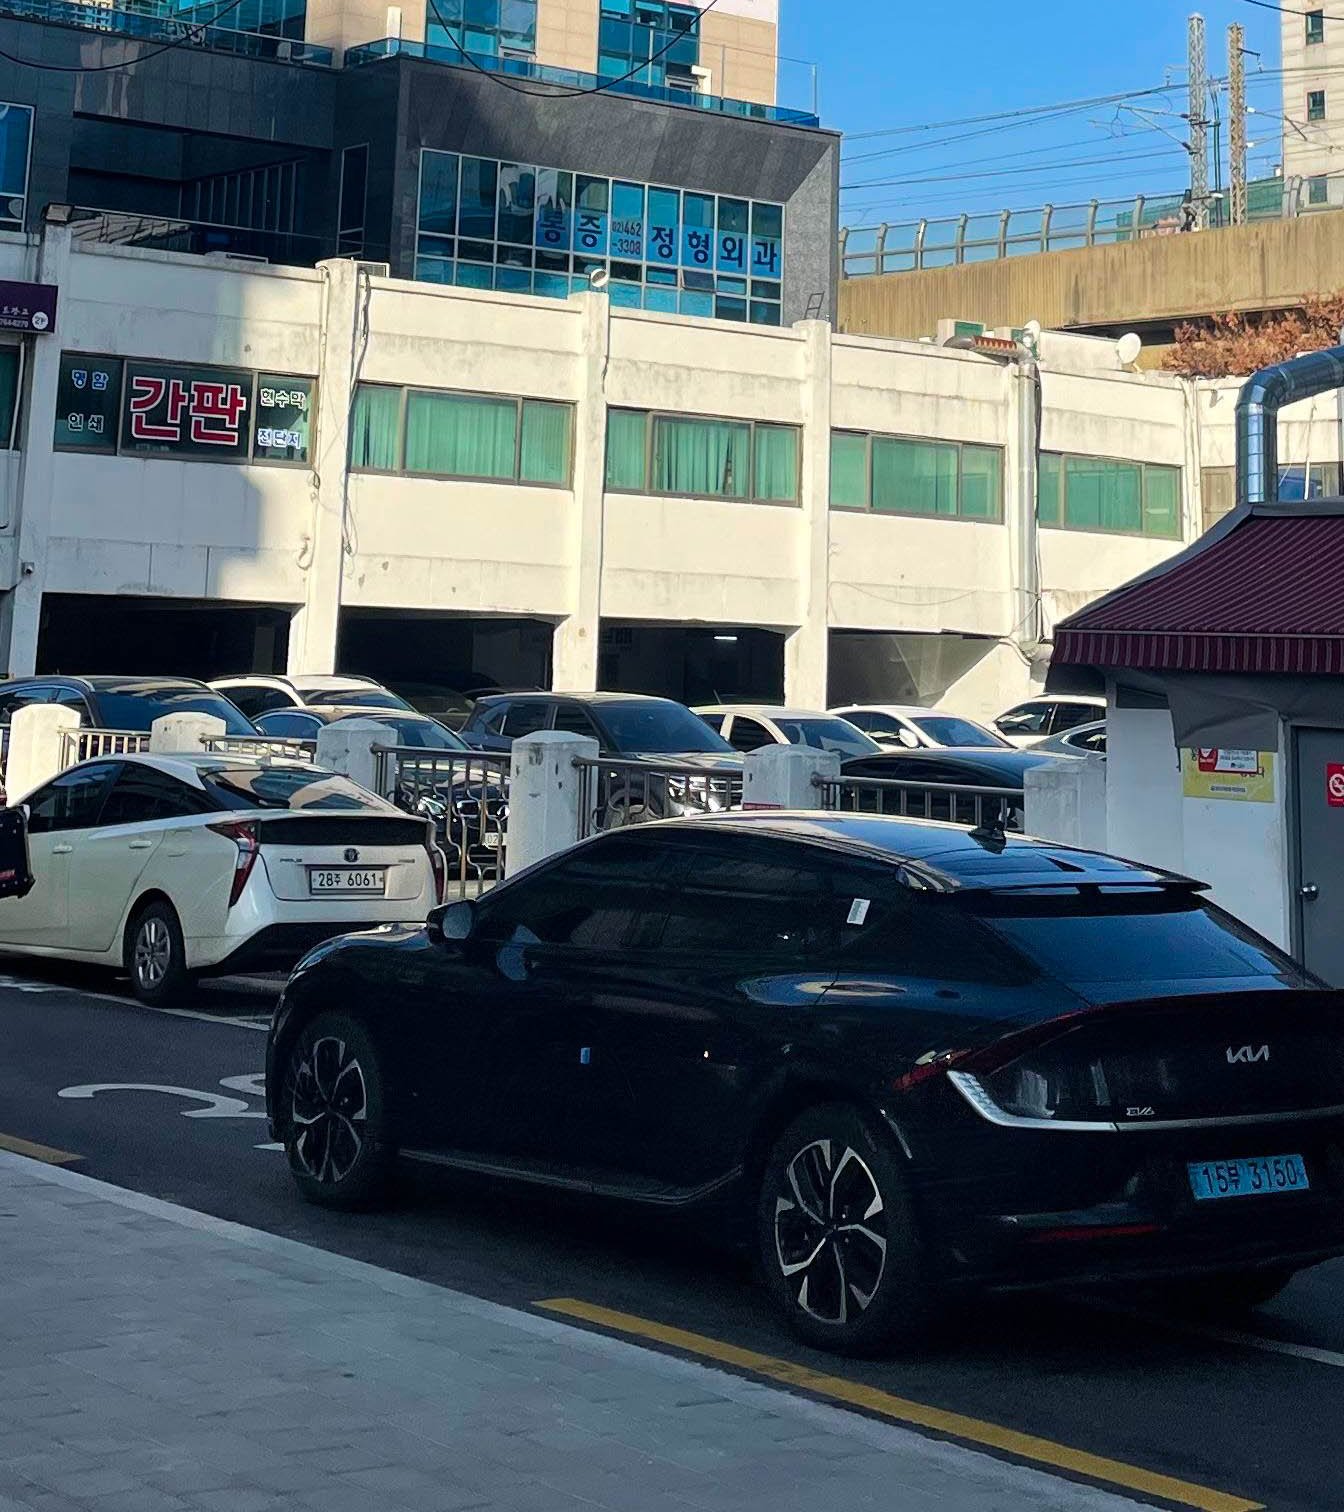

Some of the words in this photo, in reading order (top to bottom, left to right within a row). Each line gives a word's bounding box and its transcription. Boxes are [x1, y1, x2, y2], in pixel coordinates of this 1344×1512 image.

[651, 226, 777, 273] 정형외과
[260, 388, 307, 410] 현수막
[129, 376, 247, 446] 간판
[68, 412, 105, 434] 인쇄
[257, 427, 301, 450] 전단지
[318, 872, 342, 887] 28주
[347, 872, 377, 887] 6061
[1248, 1159, 1298, 1190] 3150
